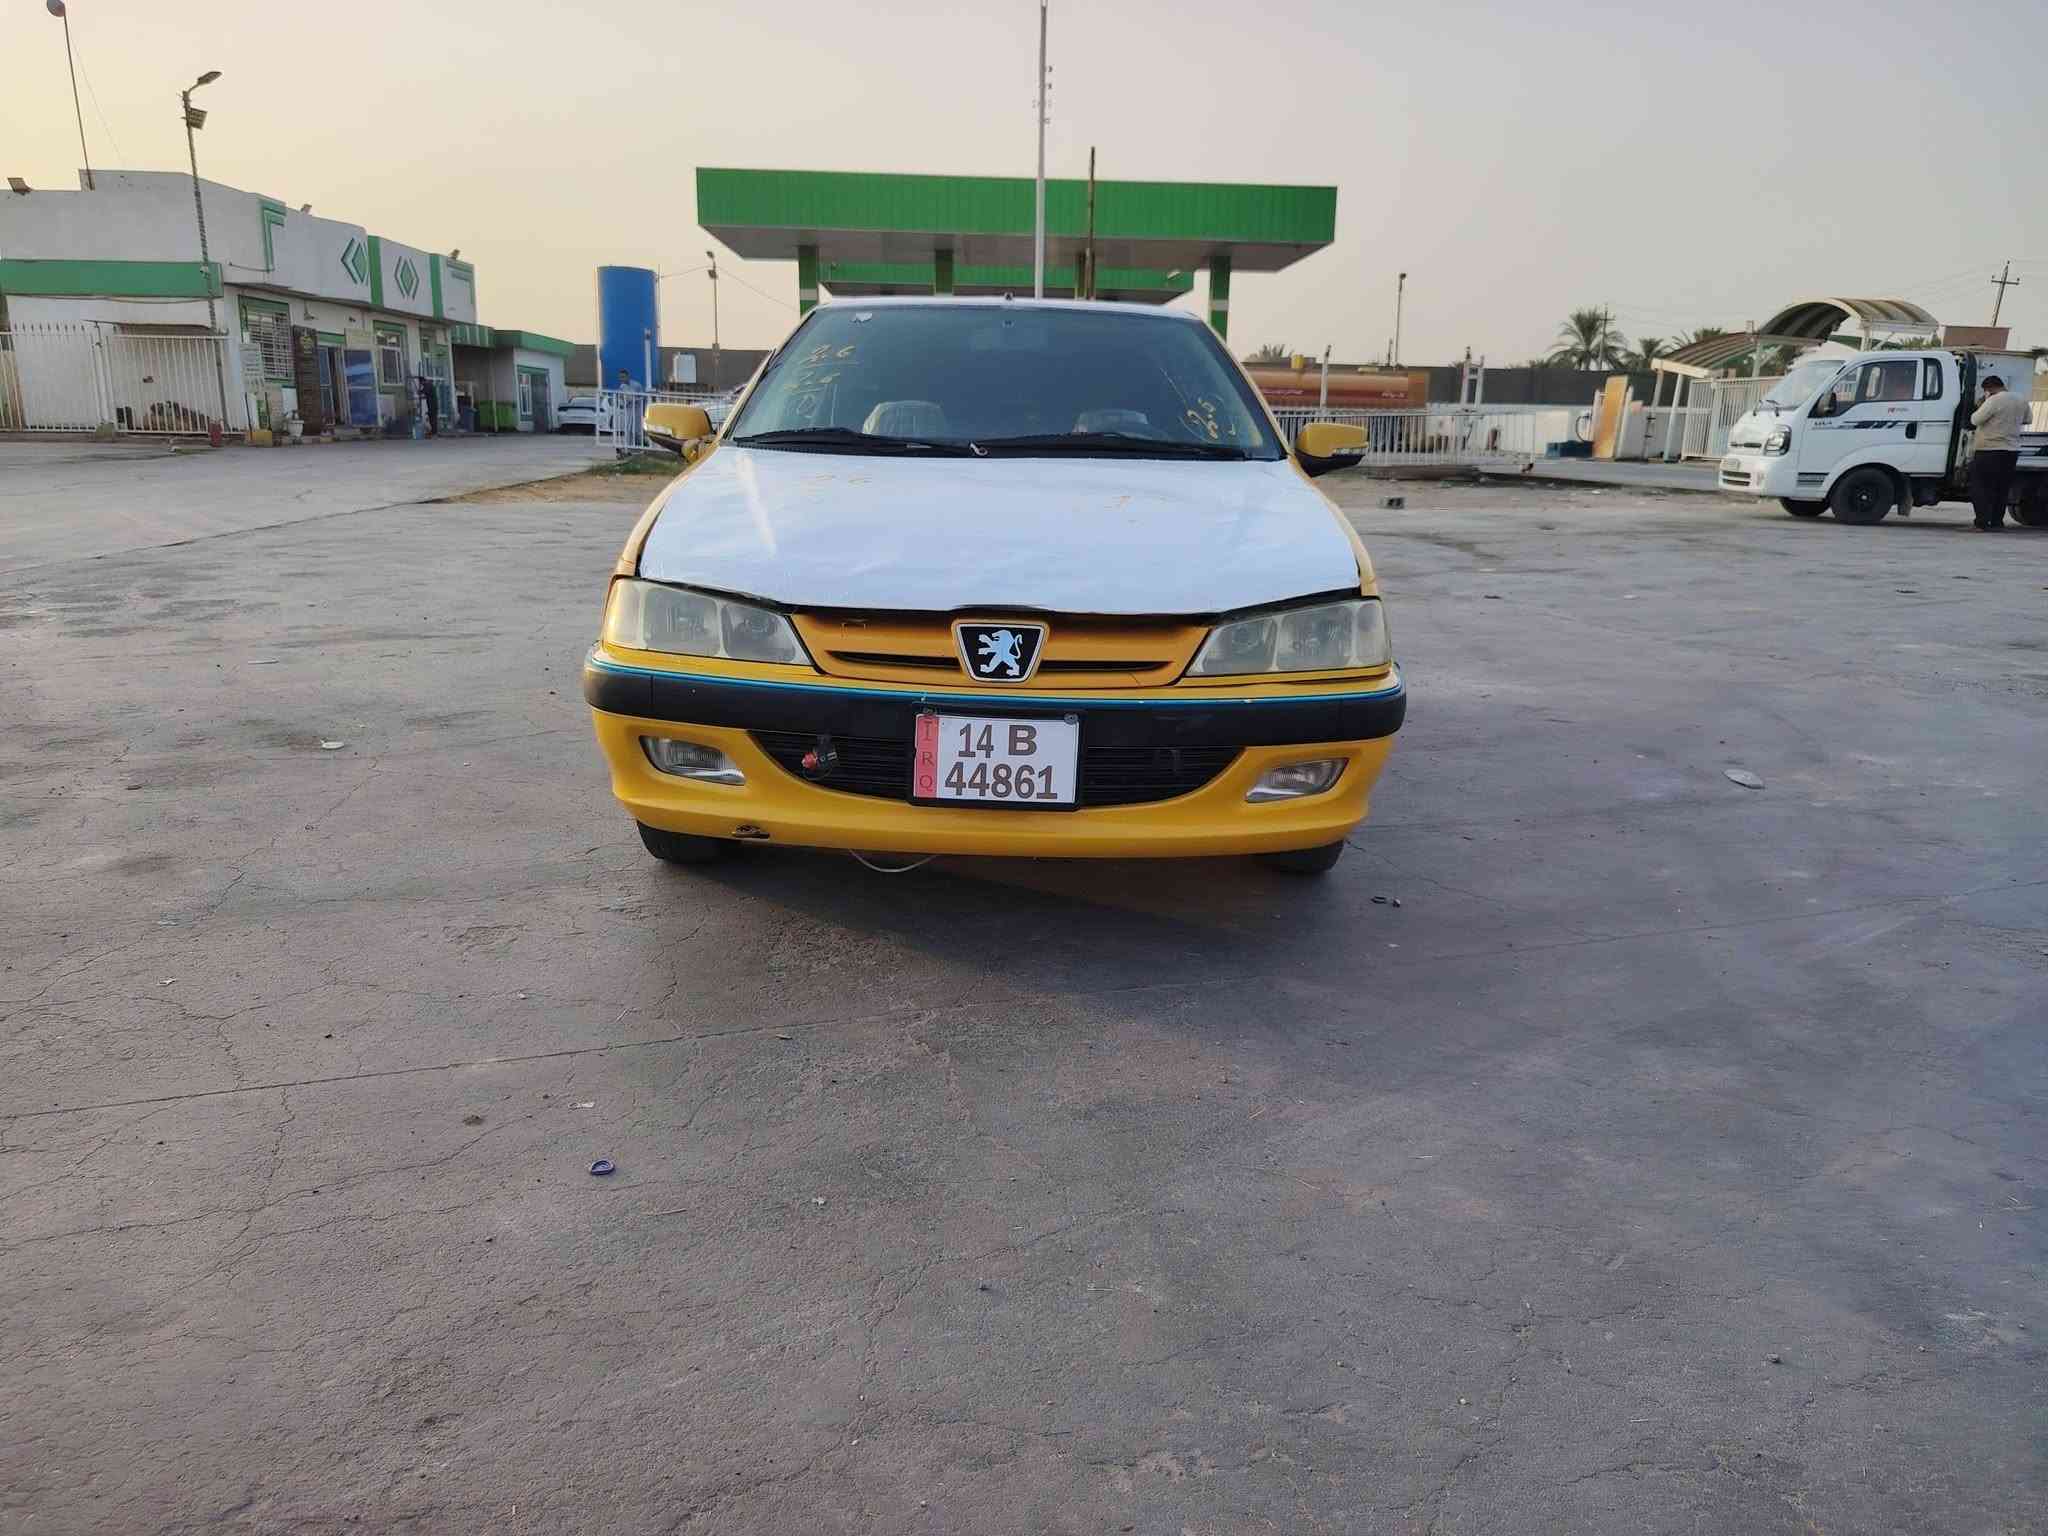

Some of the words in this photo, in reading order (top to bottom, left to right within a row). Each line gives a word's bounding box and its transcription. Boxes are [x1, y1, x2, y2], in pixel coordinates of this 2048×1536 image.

[958, 723, 994, 758] 14
[1008, 724, 1037, 756] B
[944, 761, 1058, 800] 44861
